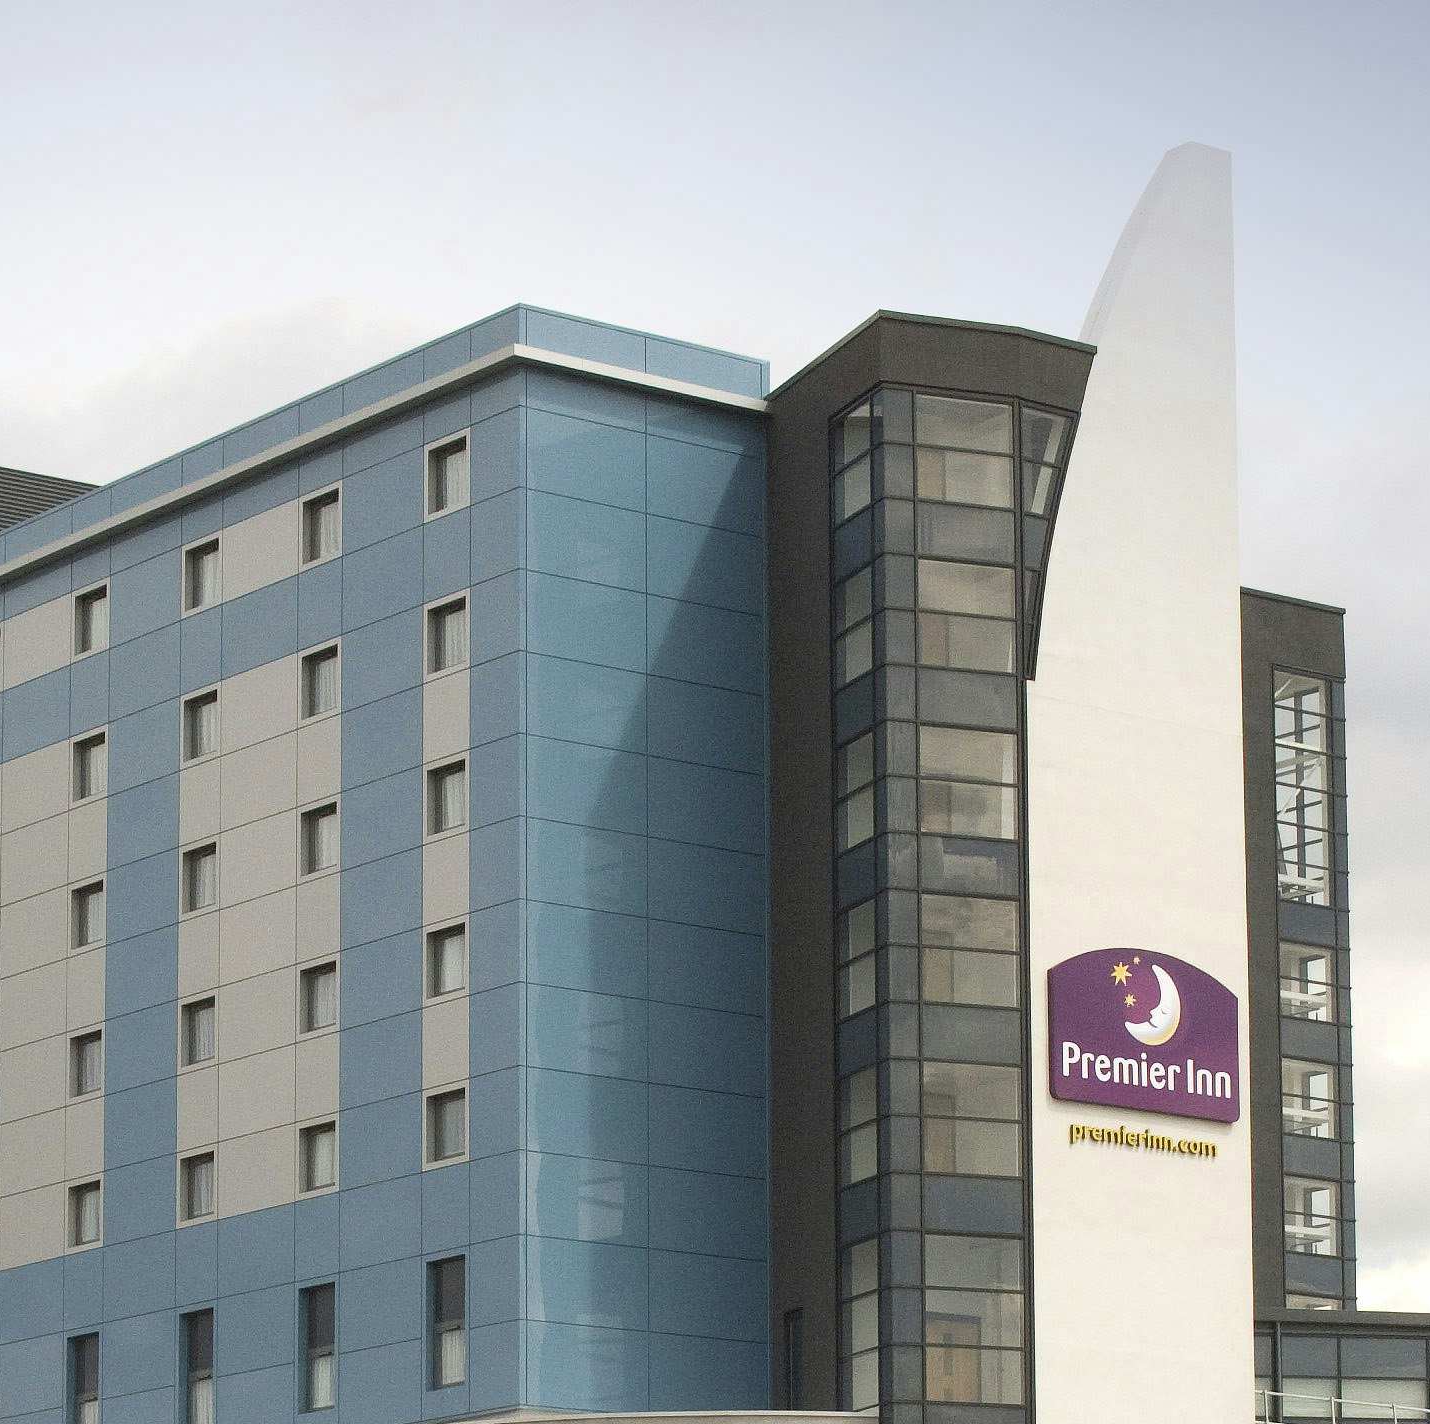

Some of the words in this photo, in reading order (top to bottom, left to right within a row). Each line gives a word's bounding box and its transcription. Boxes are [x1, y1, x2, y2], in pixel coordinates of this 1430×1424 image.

[1062, 1041, 1181, 1091] Premier
[1187, 1059, 1232, 1099] Inn
[1069, 1123, 1218, 1157] premierinn.com
